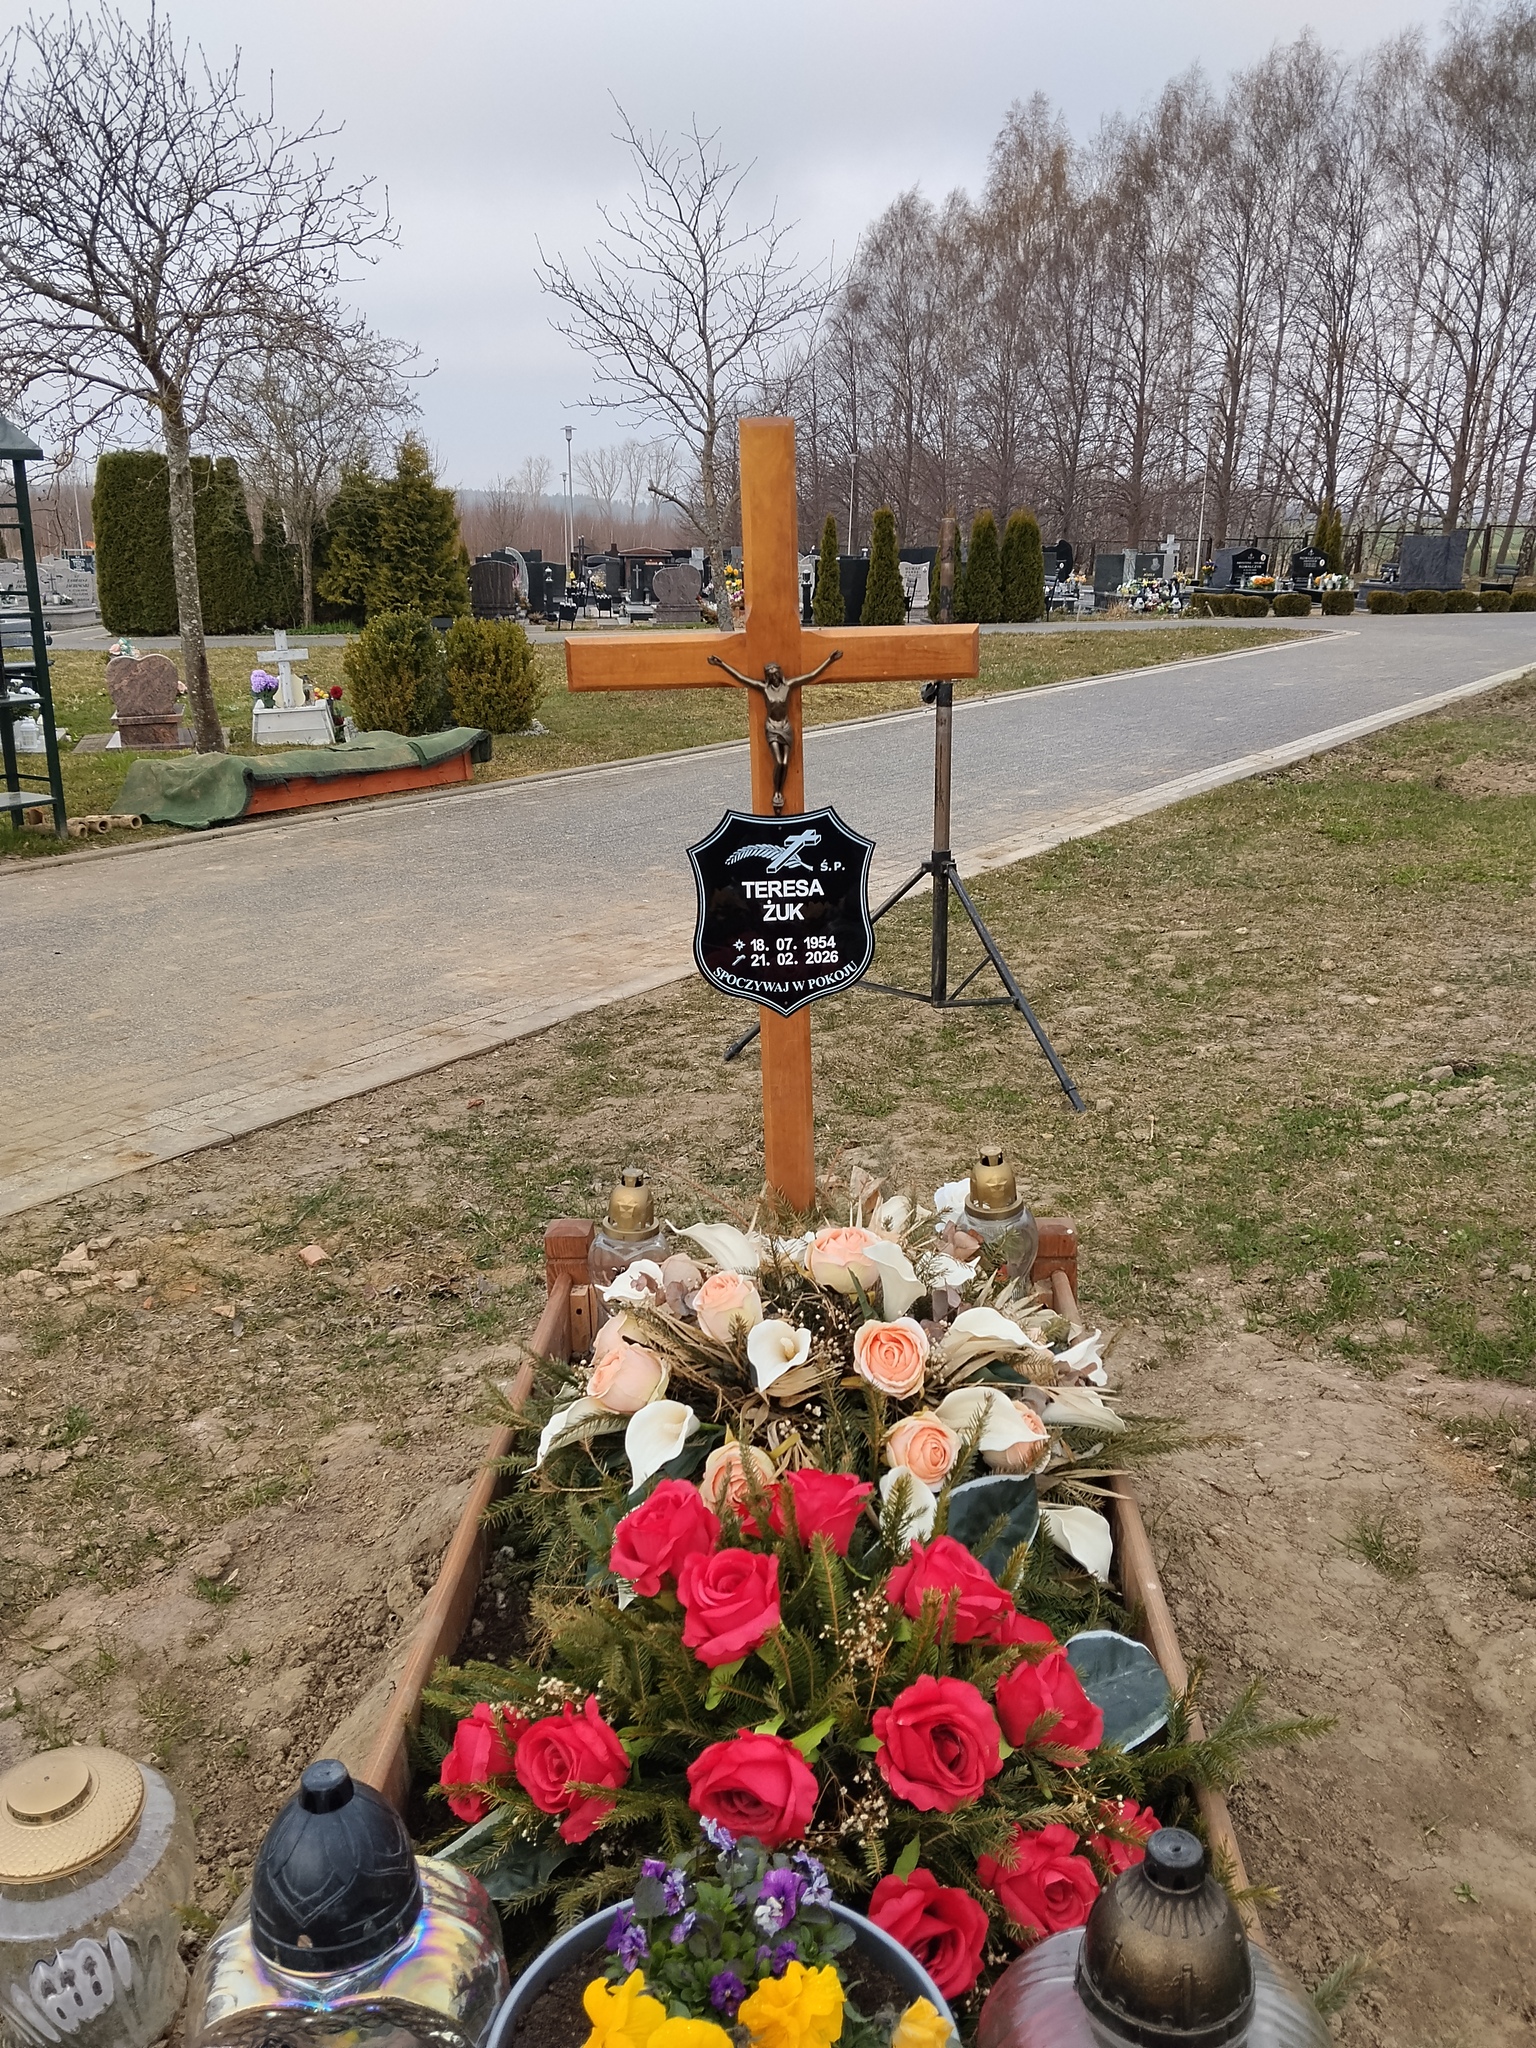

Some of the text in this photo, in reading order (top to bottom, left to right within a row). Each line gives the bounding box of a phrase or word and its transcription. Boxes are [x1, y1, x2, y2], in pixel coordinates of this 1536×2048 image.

[741, 878, 825, 899] TERESA
[762, 899, 805, 922] ŻUK
[750, 935, 837, 952] 18. 07. 1954
[750, 950, 839, 967] 21. 02. 2026
[713, 960, 858, 993] SPOCZYWAJ W POKOJU
